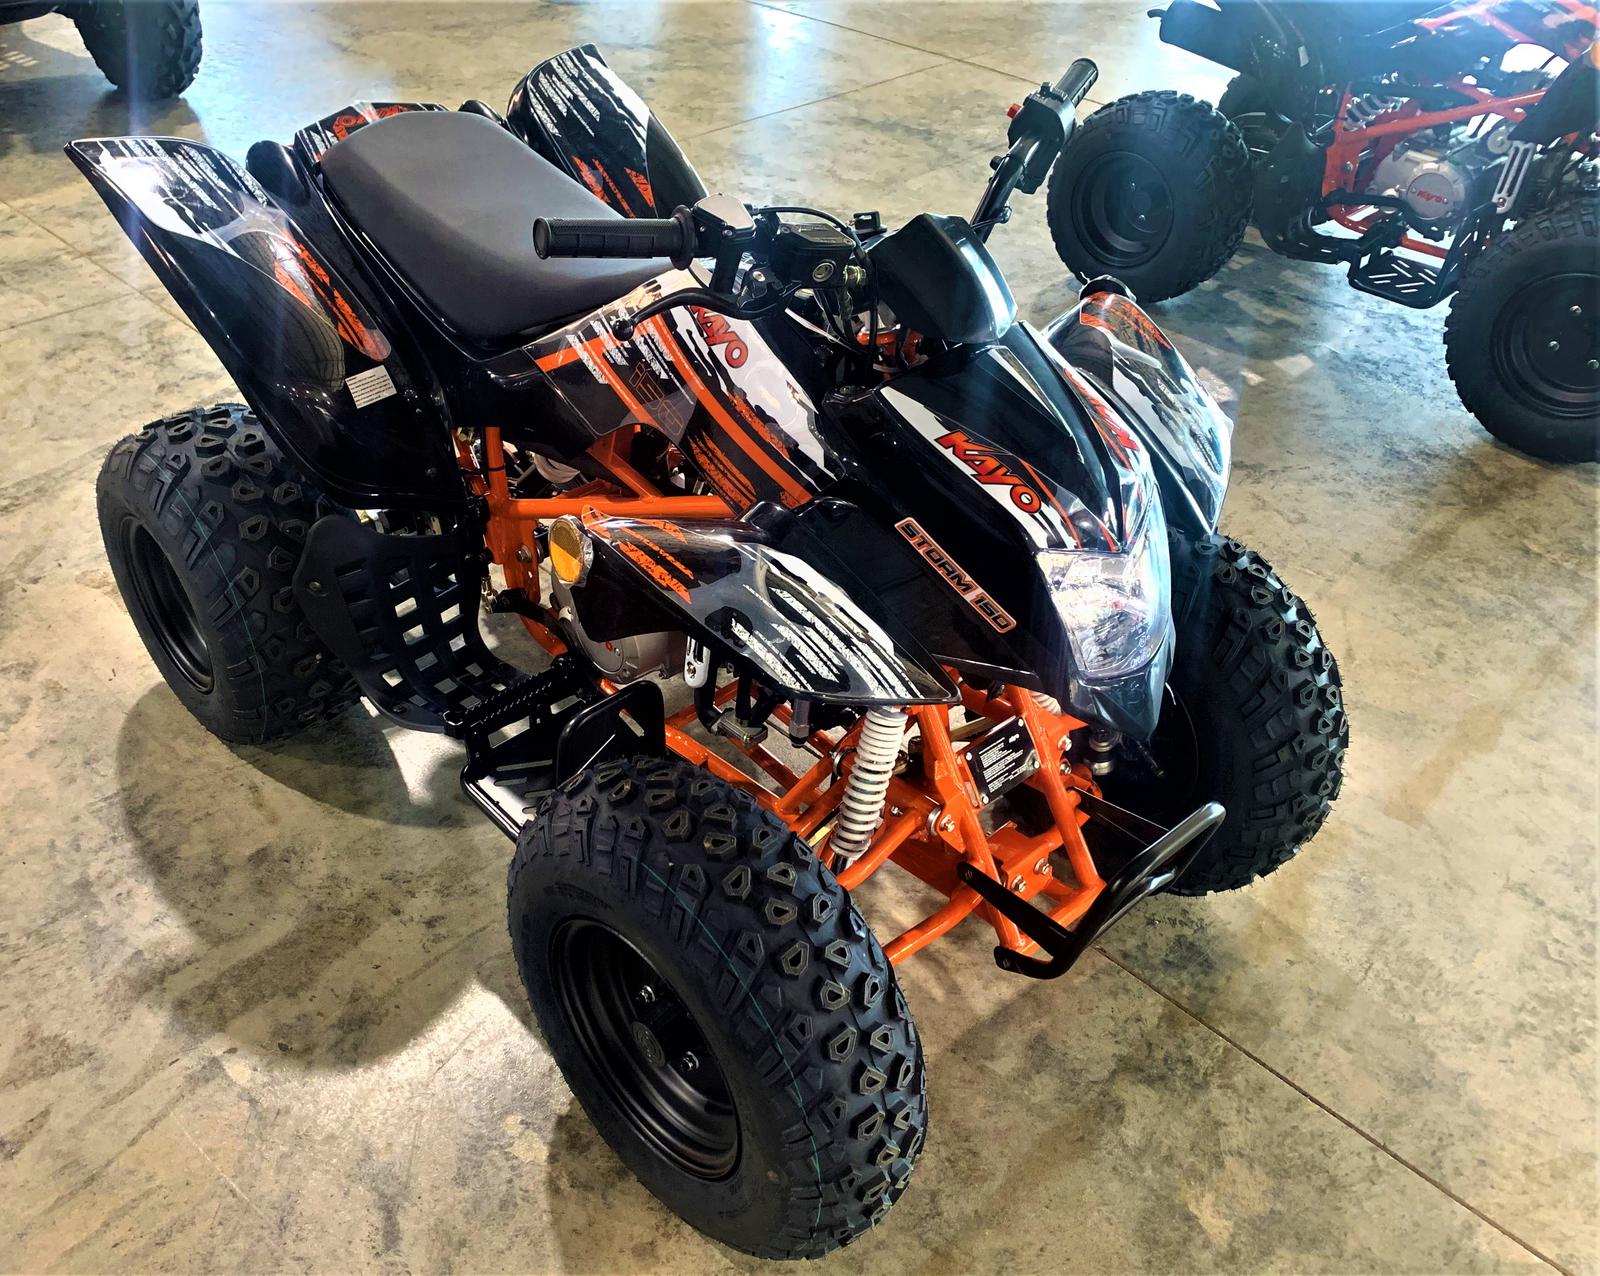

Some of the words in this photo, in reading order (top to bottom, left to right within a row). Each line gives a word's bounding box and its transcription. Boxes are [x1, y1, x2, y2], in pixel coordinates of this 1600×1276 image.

[934, 429, 1042, 514] KAYO
[899, 520, 978, 594] STORM
[971, 593, 1012, 631] 150
